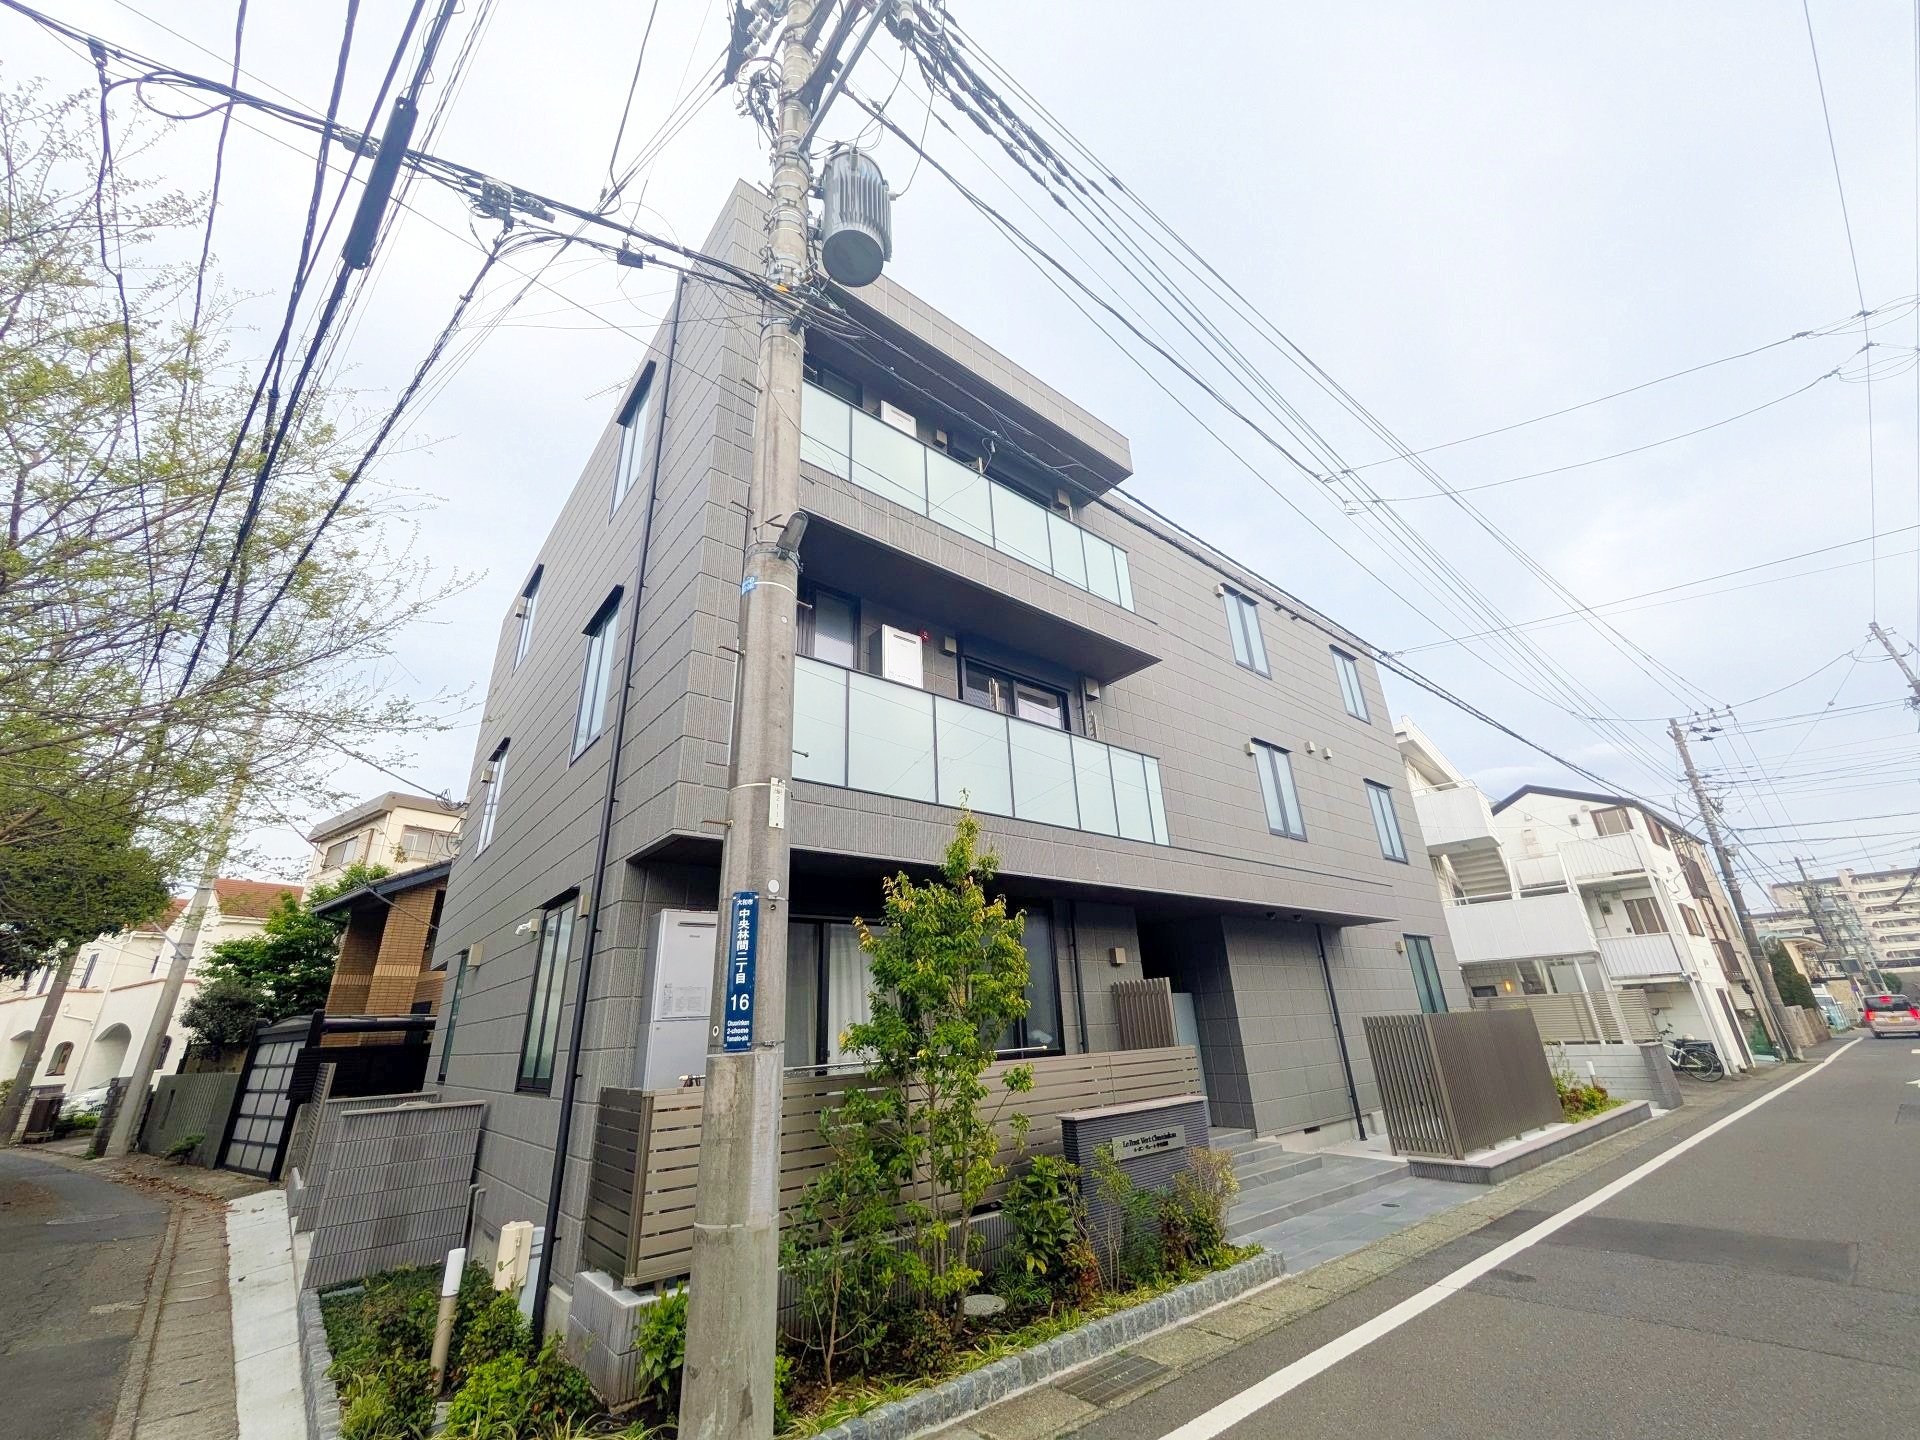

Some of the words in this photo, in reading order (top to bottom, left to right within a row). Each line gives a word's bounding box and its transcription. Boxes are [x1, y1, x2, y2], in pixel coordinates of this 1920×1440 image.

[735, 908, 750, 984] 中央林間二丁目
[730, 993, 750, 1011] 16
